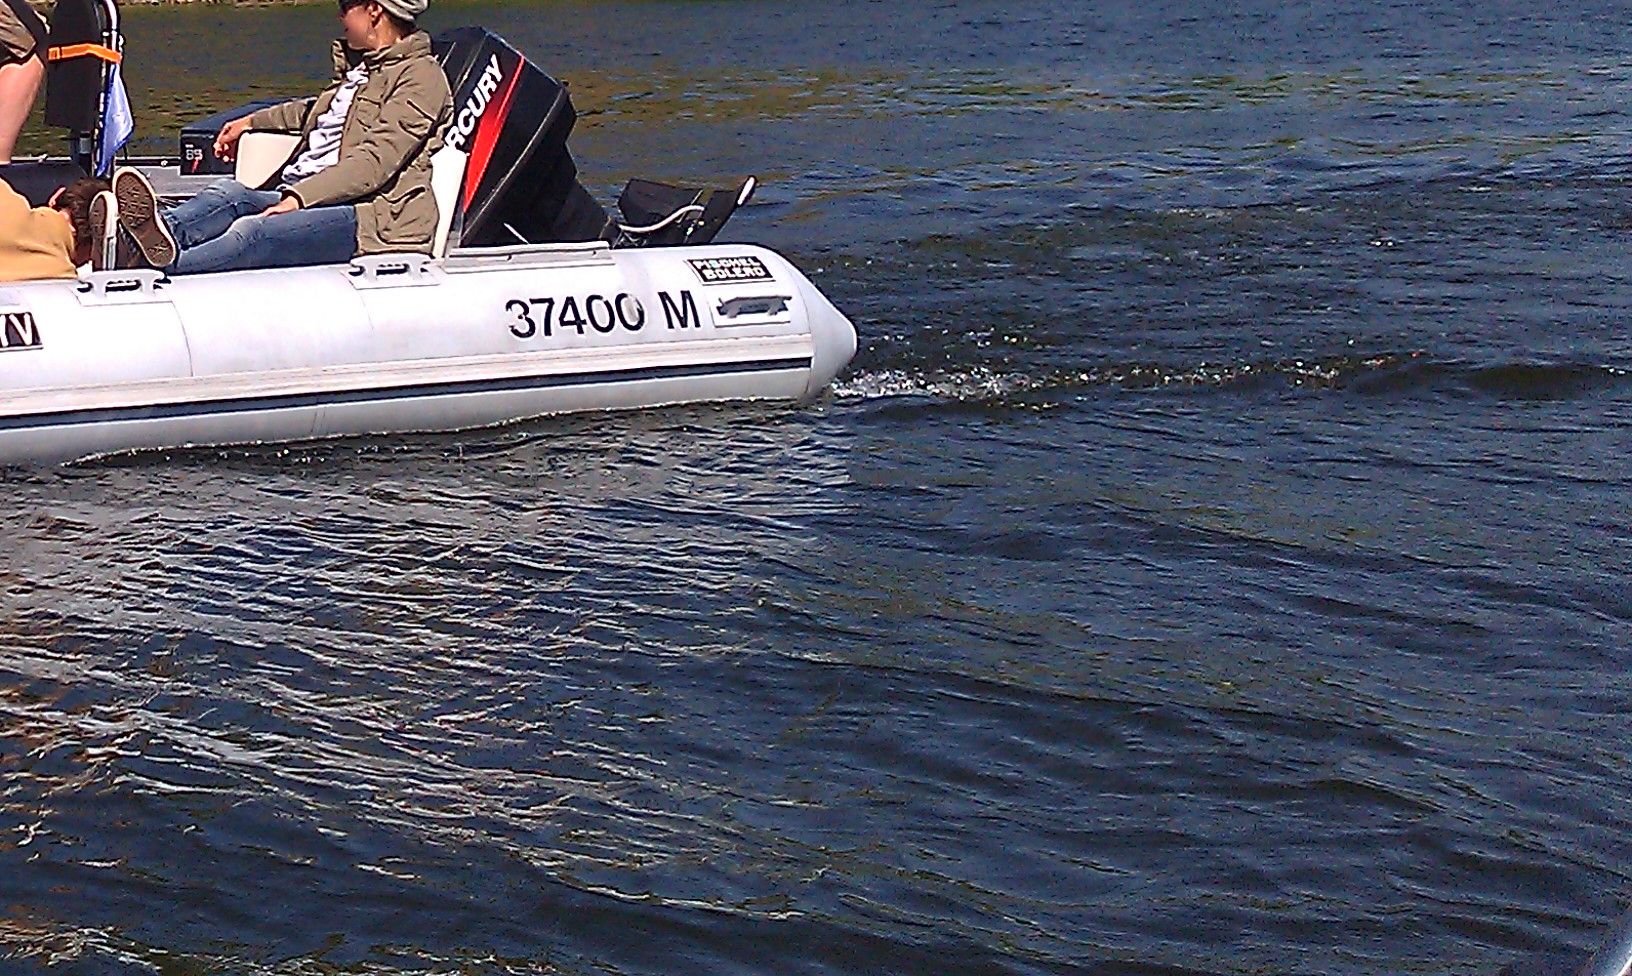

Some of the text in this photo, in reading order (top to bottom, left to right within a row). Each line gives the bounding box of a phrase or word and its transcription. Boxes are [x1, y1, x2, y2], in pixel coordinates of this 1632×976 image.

[444, 53, 504, 149] RCURY
[505, 290, 701, 339] 37400 M
